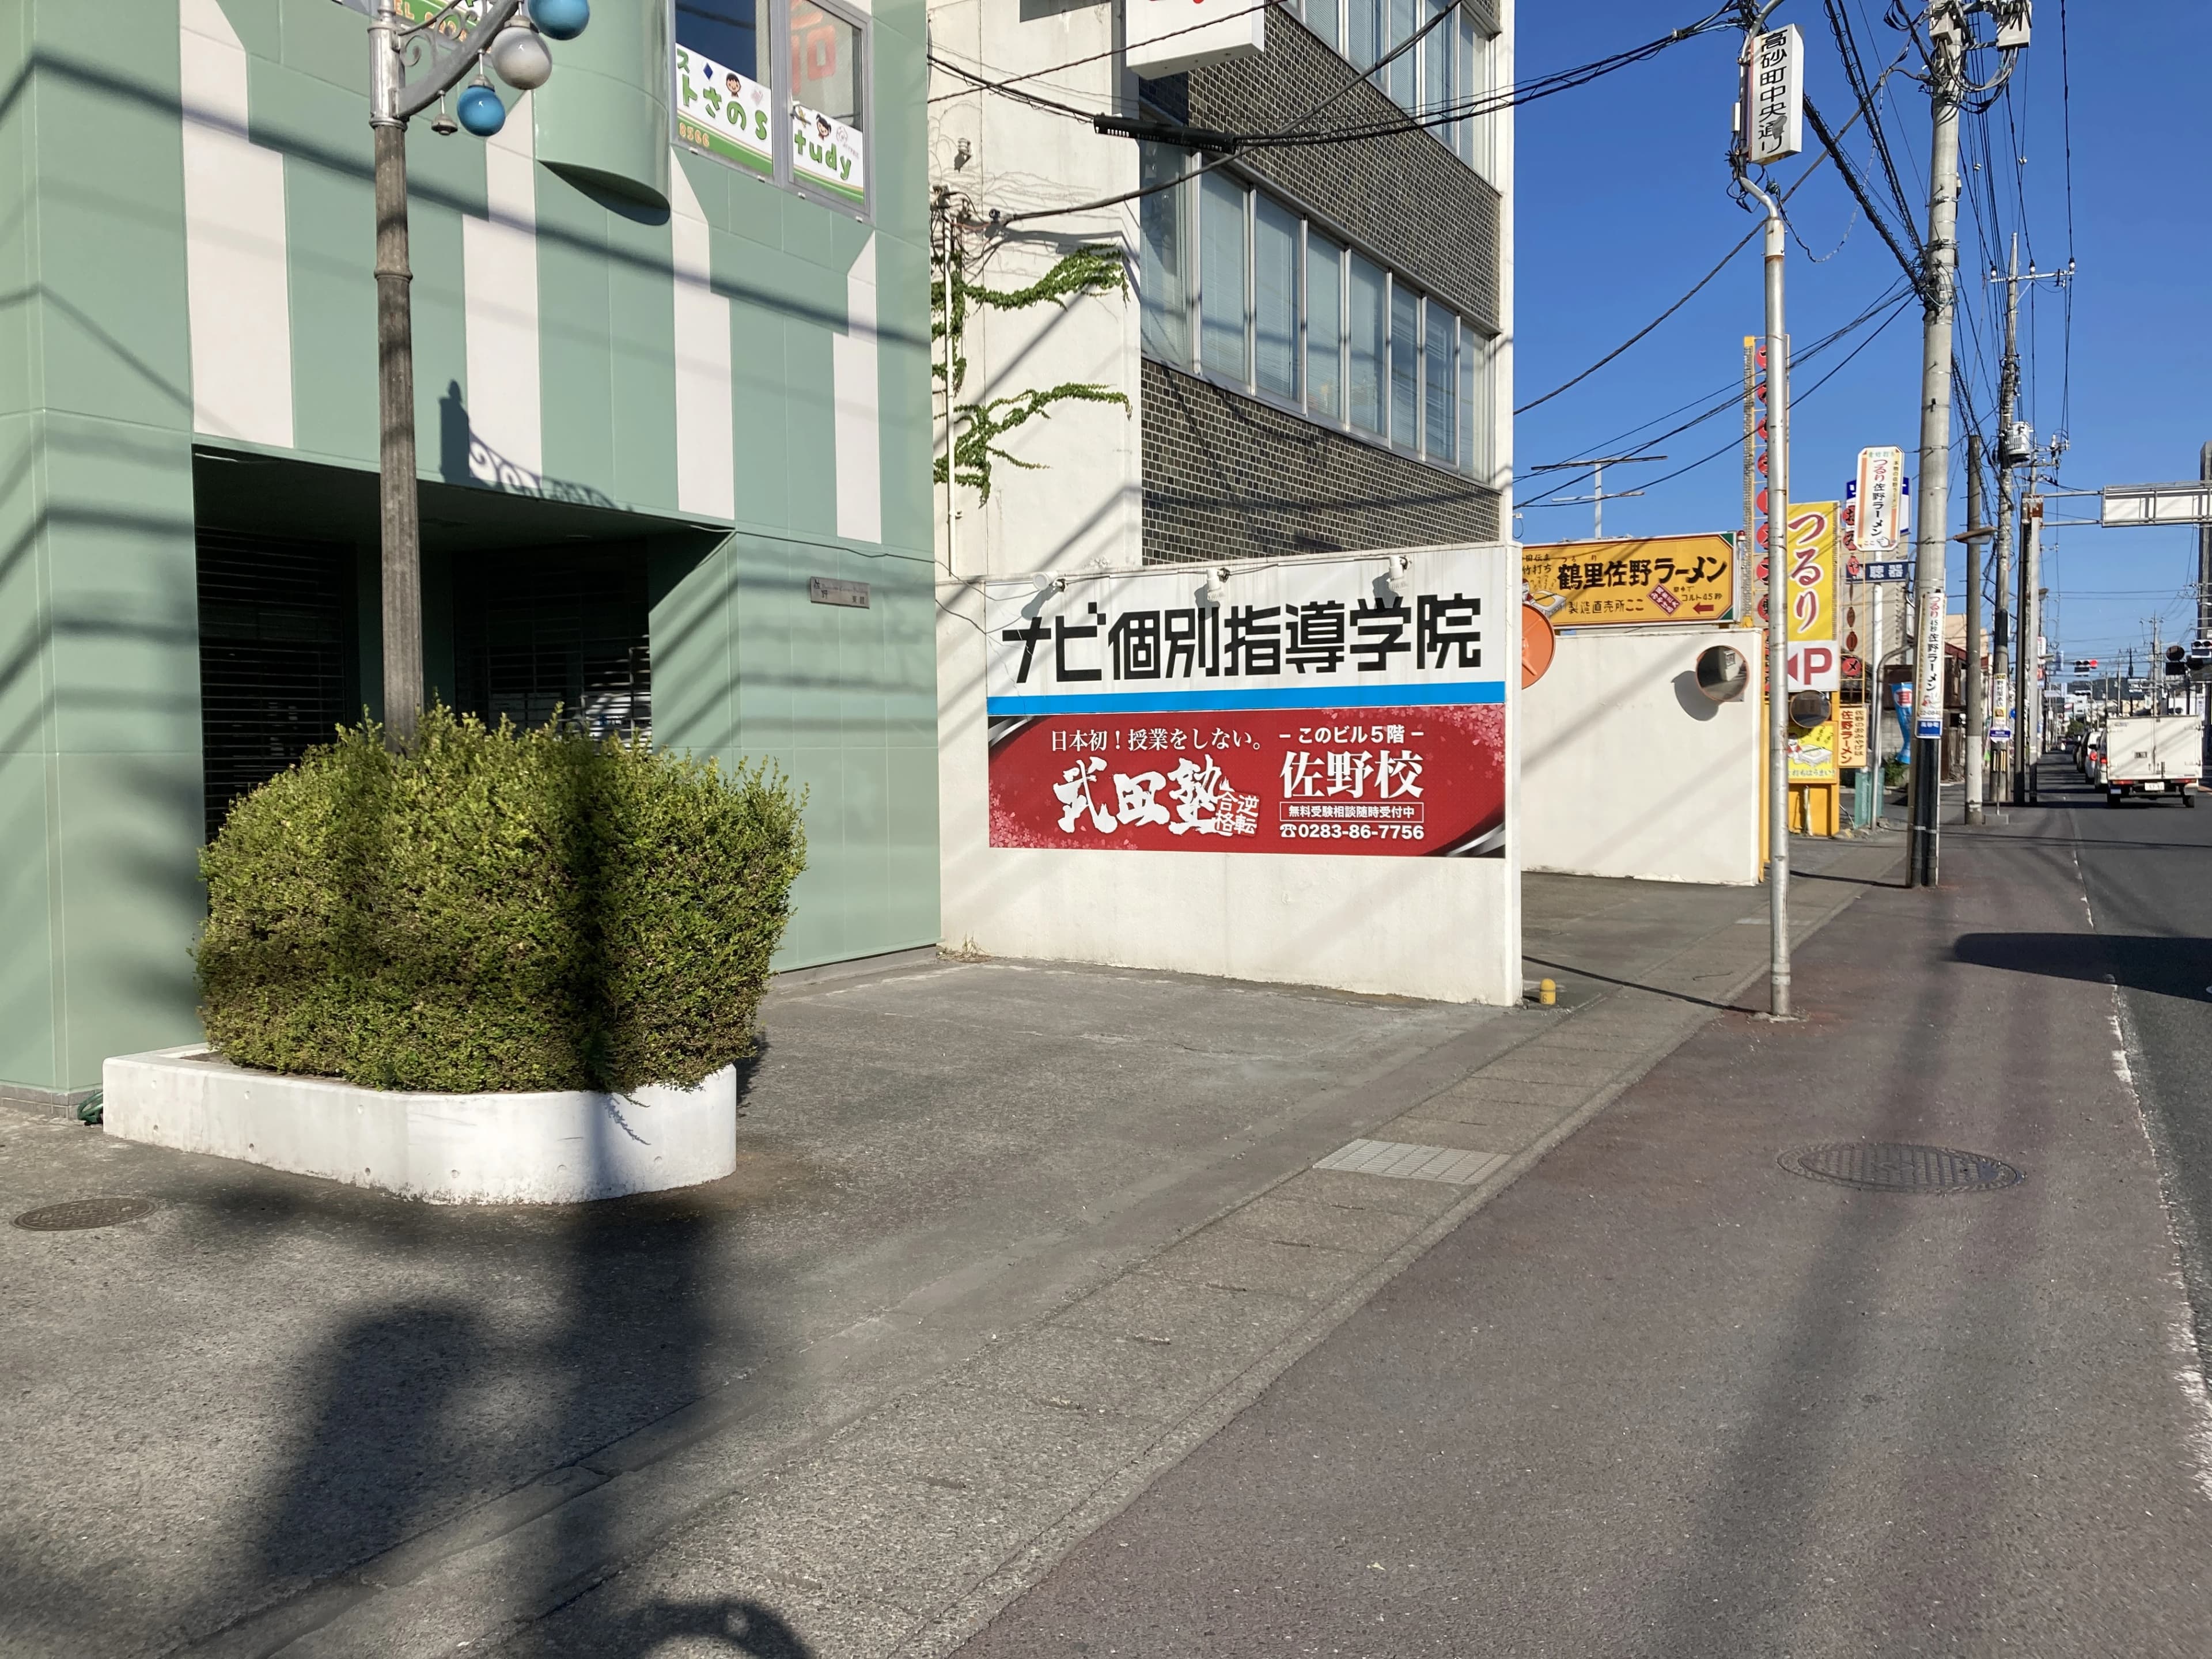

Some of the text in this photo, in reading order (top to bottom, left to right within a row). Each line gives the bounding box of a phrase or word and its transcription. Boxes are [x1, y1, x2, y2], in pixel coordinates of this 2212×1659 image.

[1556, 556, 1728, 590] 鶴里佐野ラーメン
[1788, 514, 1827, 633] つるり
[1002, 592, 1482, 684] ナビ個別指導学院
[1804, 647, 1832, 685] P
[1840, 710, 1853, 764] 佐野ラーメン
[1053, 754, 1234, 837] 武田塾
[1279, 749, 1425, 799] 佐野校
[1288, 805, 1415, 819] 無料受験相談随時受付中
[1298, 824, 1425, 840] 0283-86-7756
